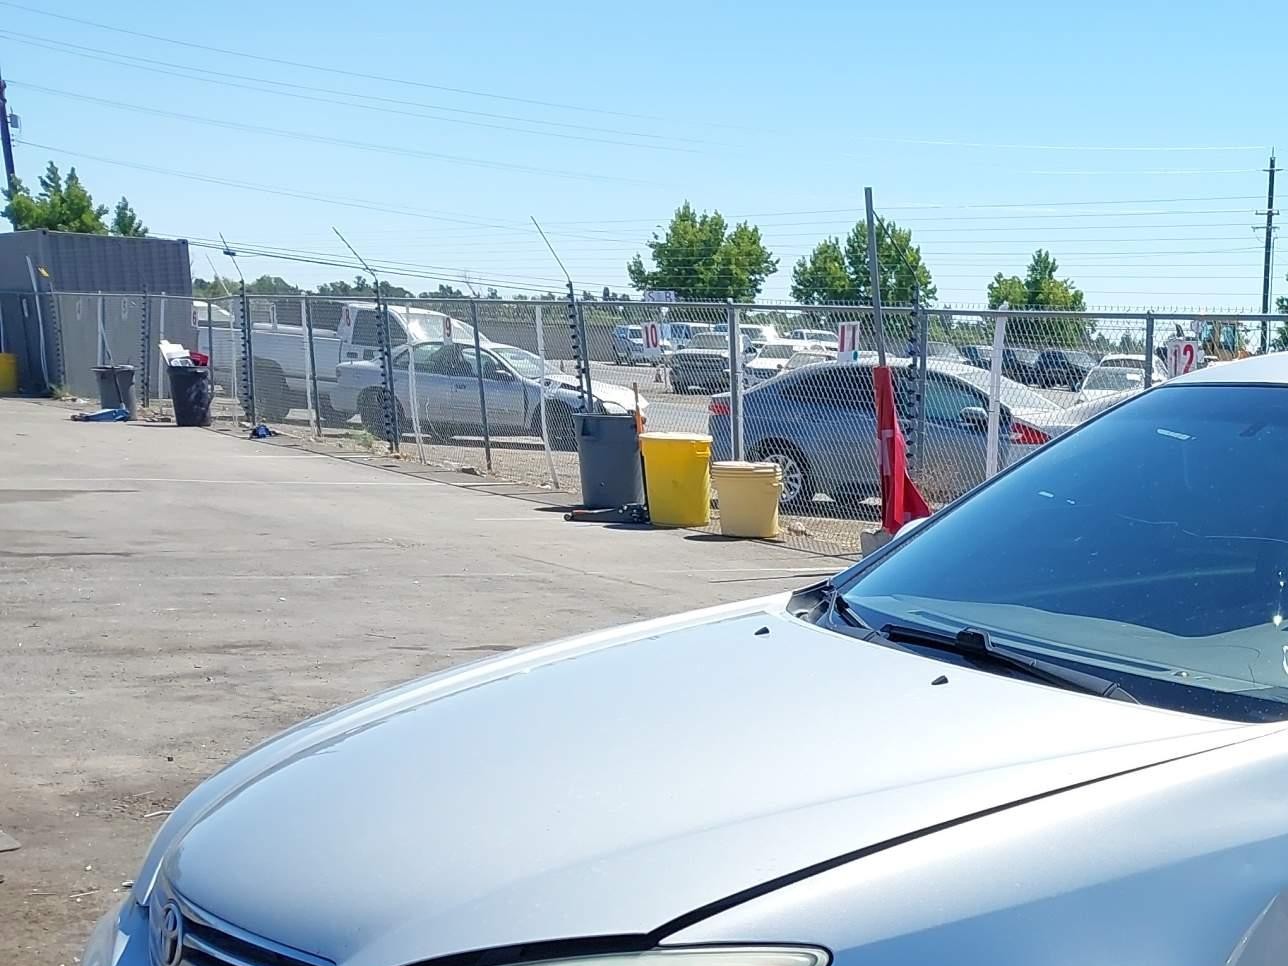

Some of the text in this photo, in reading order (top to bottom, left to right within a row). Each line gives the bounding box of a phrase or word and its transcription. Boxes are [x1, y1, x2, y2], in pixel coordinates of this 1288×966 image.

[445, 316, 451, 338] 9
[644, 323, 658, 348] 10
[1170, 344, 1194, 376] 12
